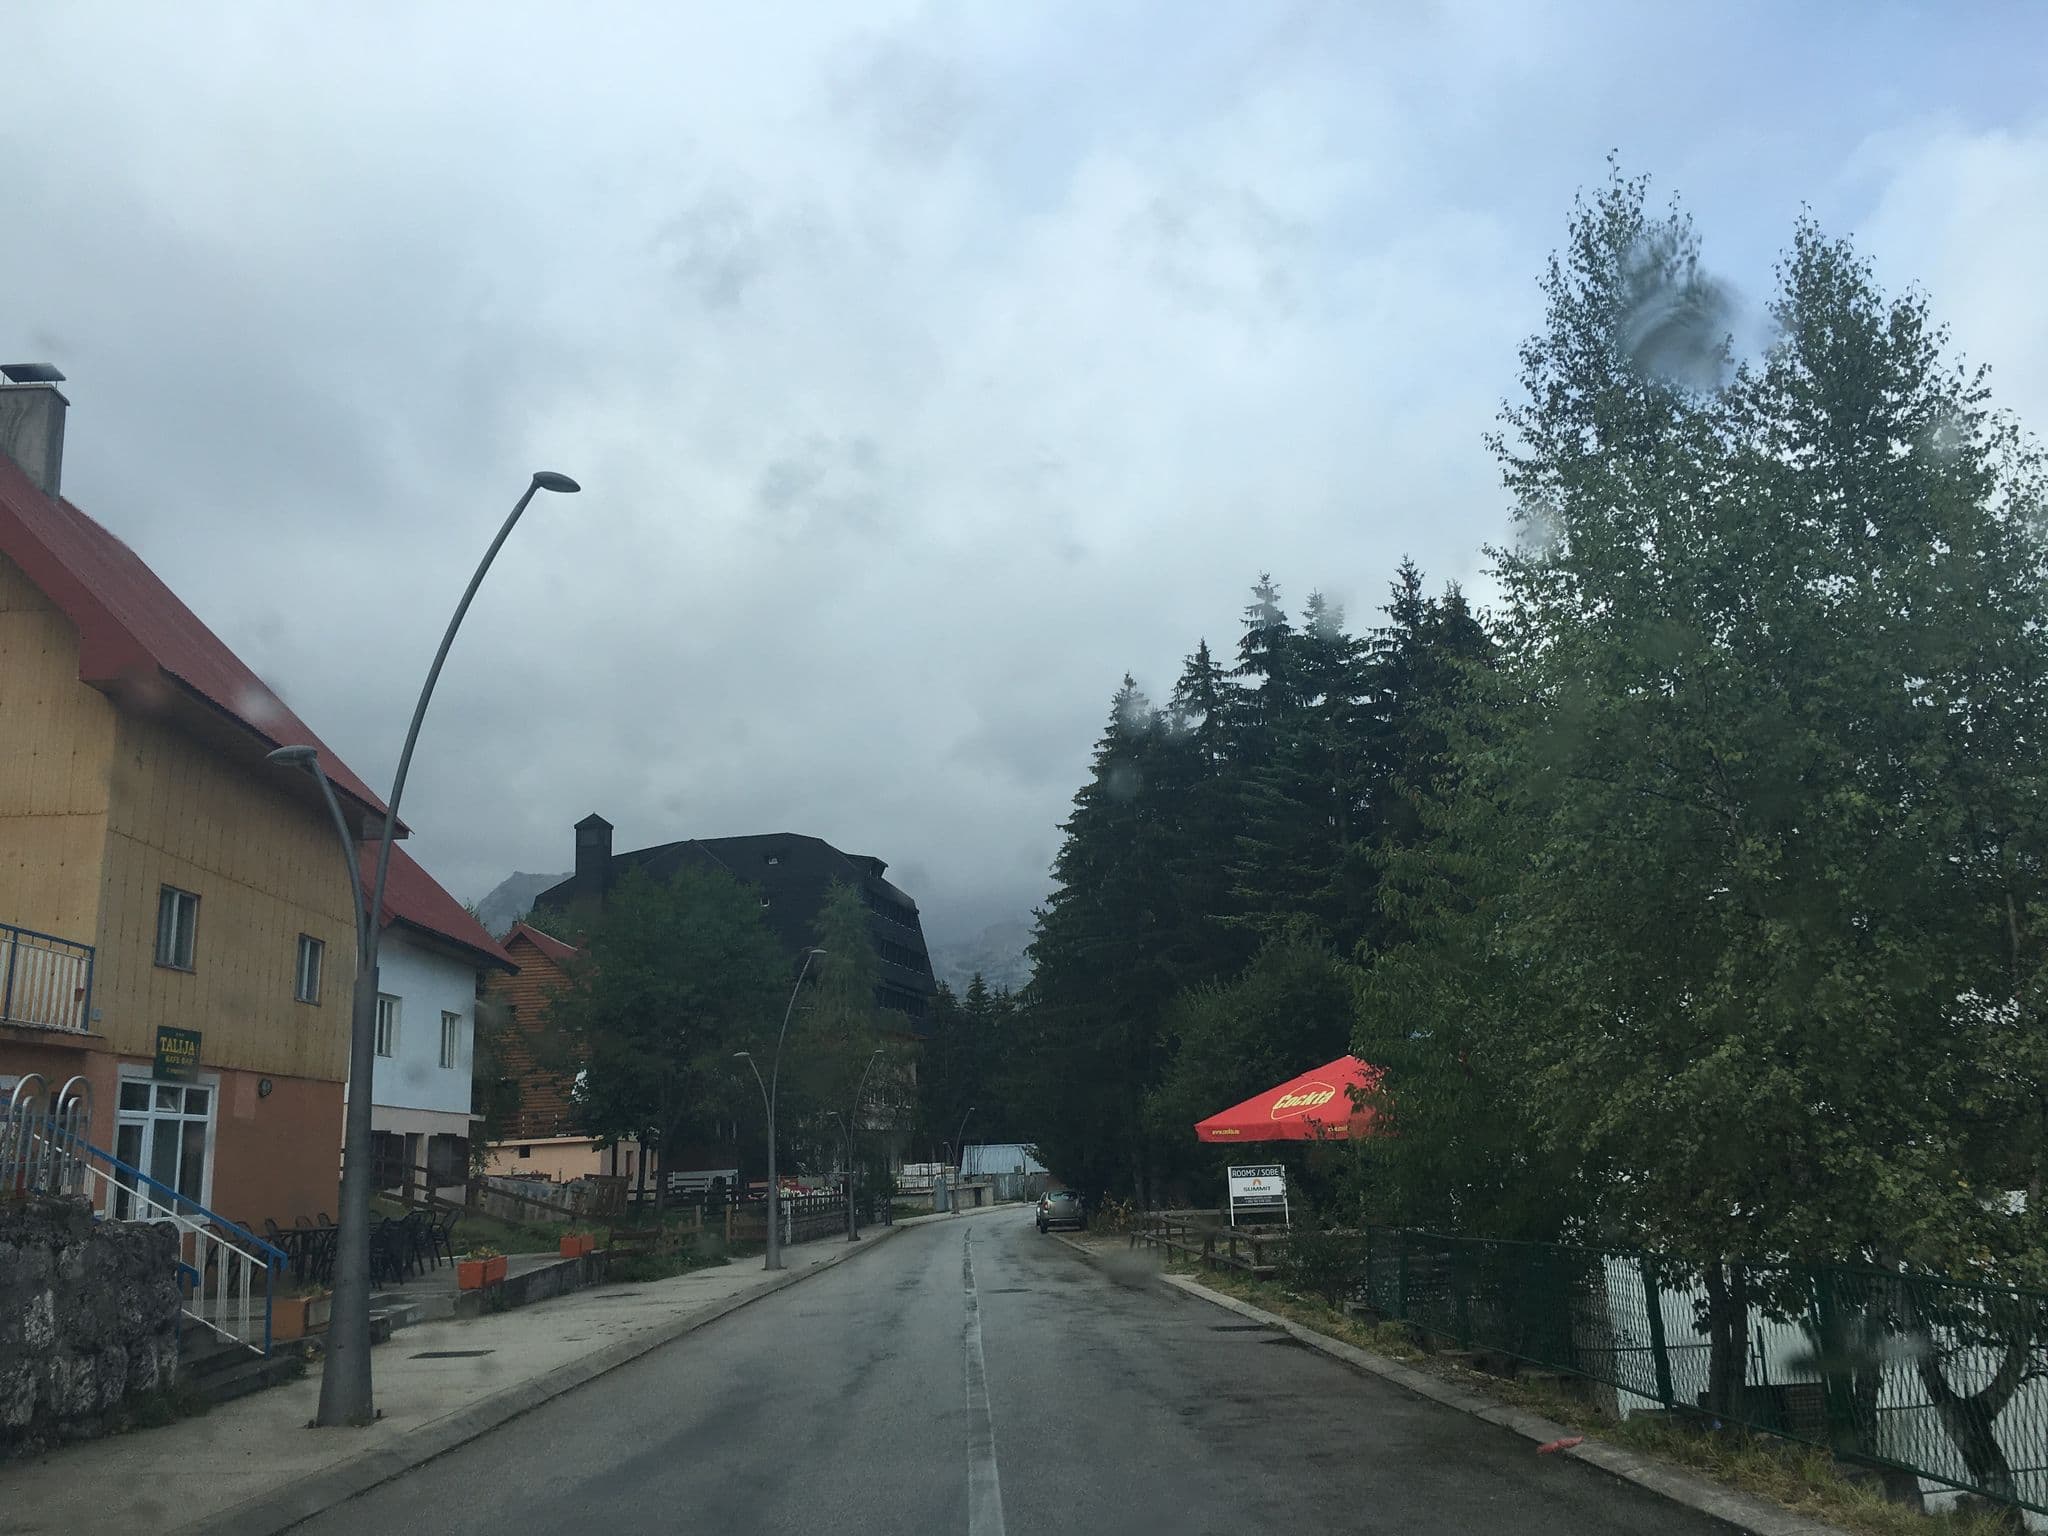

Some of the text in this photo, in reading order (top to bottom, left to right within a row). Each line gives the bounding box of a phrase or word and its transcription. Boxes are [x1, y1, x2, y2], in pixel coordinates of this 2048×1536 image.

[160, 1036, 195, 1056] TALIJA
[1232, 1169, 1255, 1177] ROOMS
[1260, 1168, 1279, 1176] SOBE
